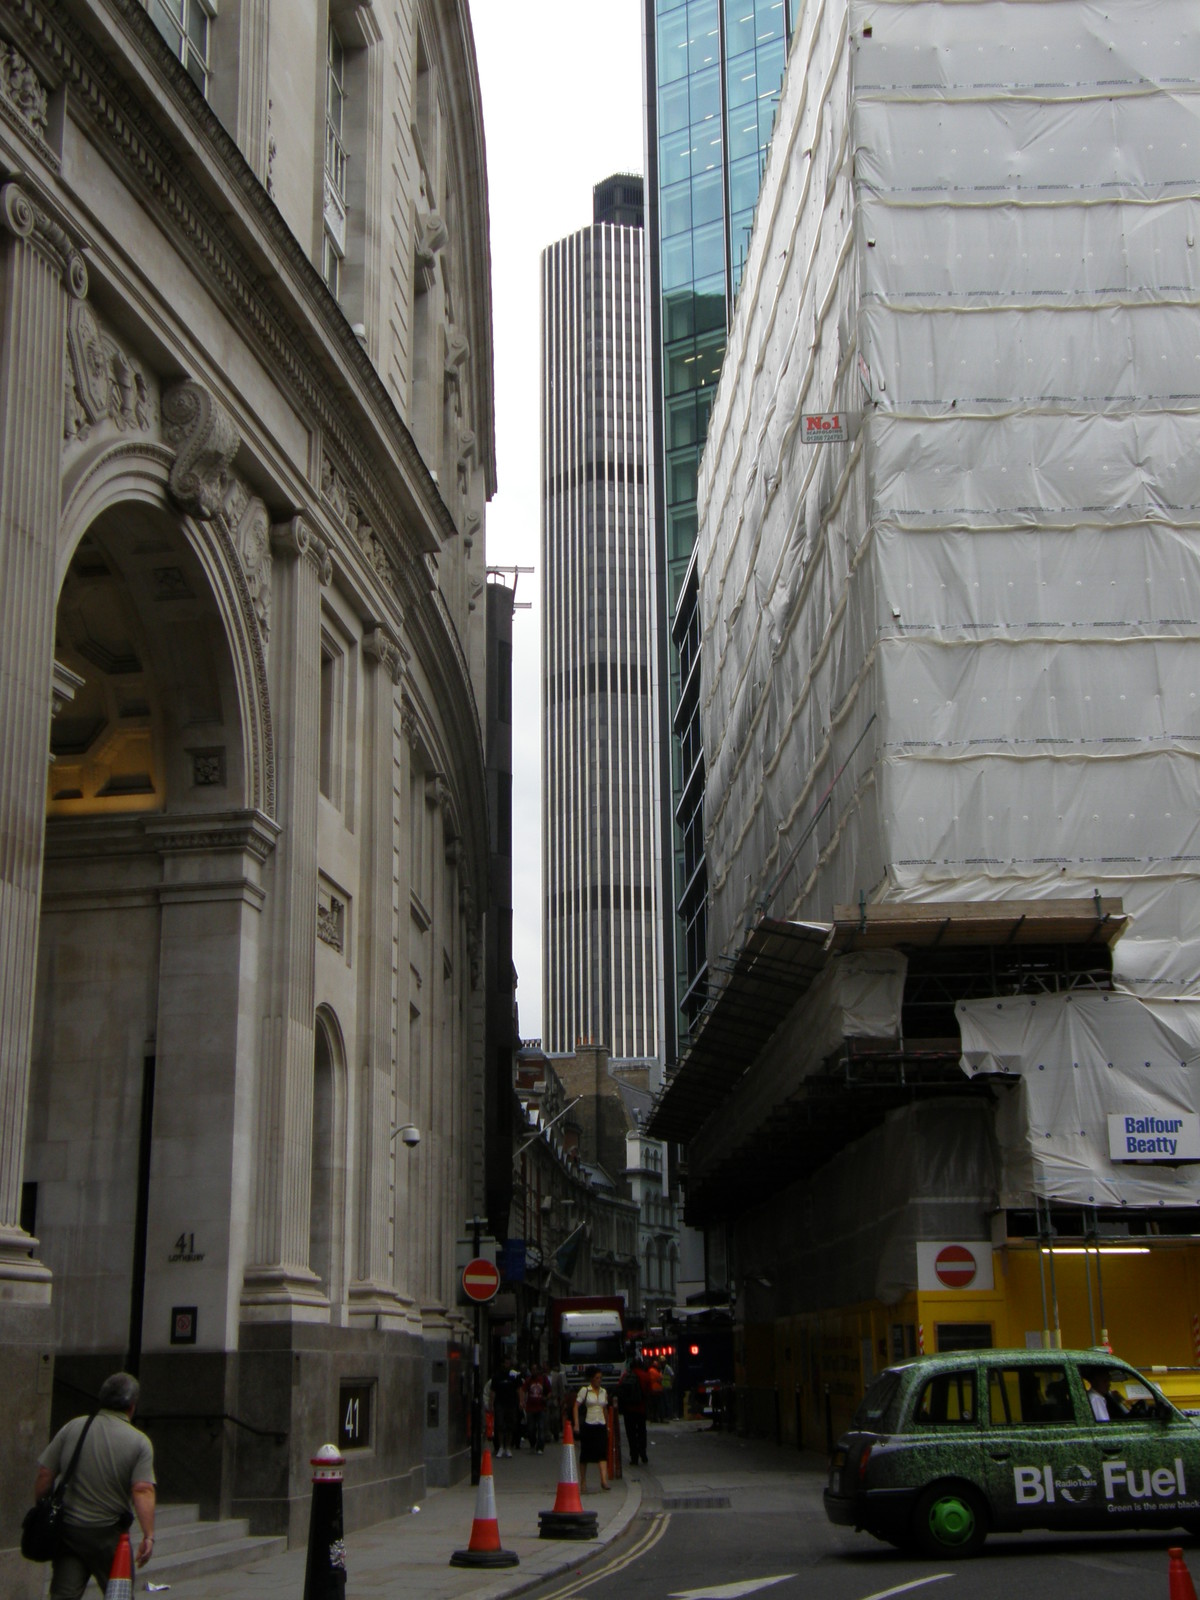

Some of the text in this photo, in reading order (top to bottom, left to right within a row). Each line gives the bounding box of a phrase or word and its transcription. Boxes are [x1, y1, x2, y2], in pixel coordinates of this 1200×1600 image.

[806, 415, 841, 431] No1
[1125, 1117, 1183, 1134] Balfour
[1126, 1136, 1177, 1155] Beatty
[174, 1232, 195, 1253] 41
[168, 1253, 205, 1263] LOTHBURY
[344, 1397, 360, 1438] 41
[1102, 1458, 1187, 1499] Fuel
[1107, 1503, 1133, 1513] Green
[1134, 1502, 1142, 1511] is
[1143, 1502, 1157, 1511] the
[1158, 1502, 1176, 1510] new
